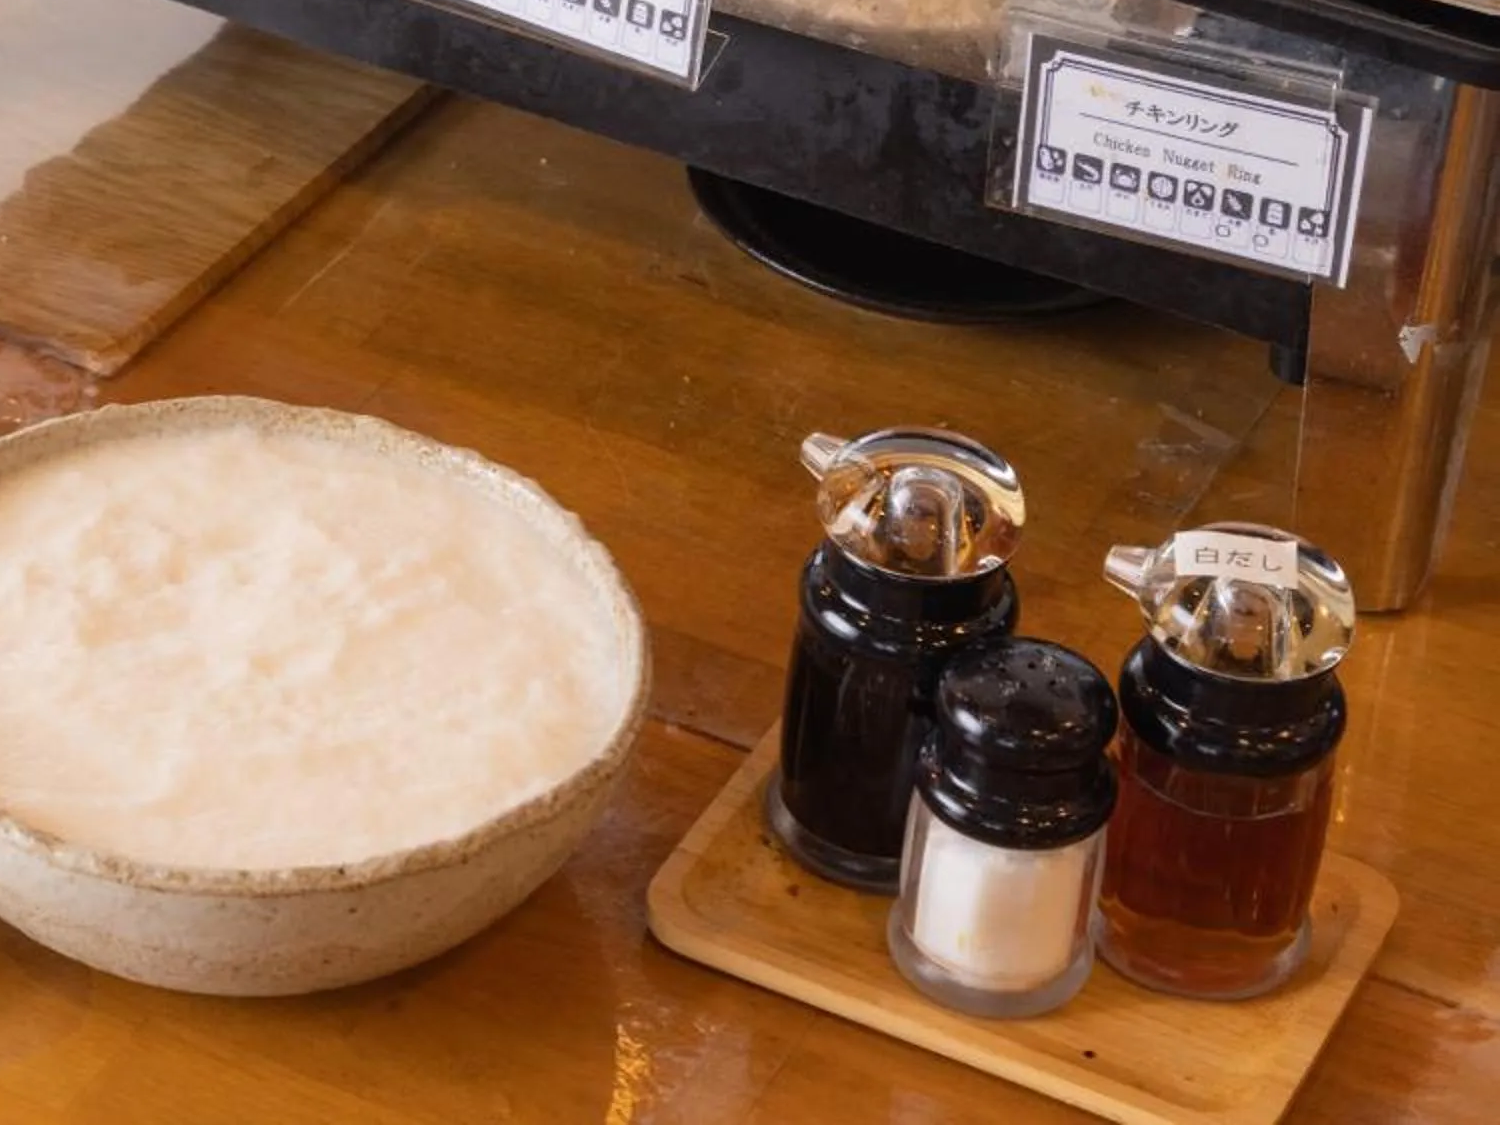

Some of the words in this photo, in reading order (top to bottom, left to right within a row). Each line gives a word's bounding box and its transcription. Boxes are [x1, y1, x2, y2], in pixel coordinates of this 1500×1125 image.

[1125, 100, 1241, 138] チキンリング
[1093, 131, 1151, 157] Chicken
[1163, 147, 1216, 175] Nugget
[1226, 163, 1263, 186] Ring
[1195, 546, 1283, 572] 白だし
